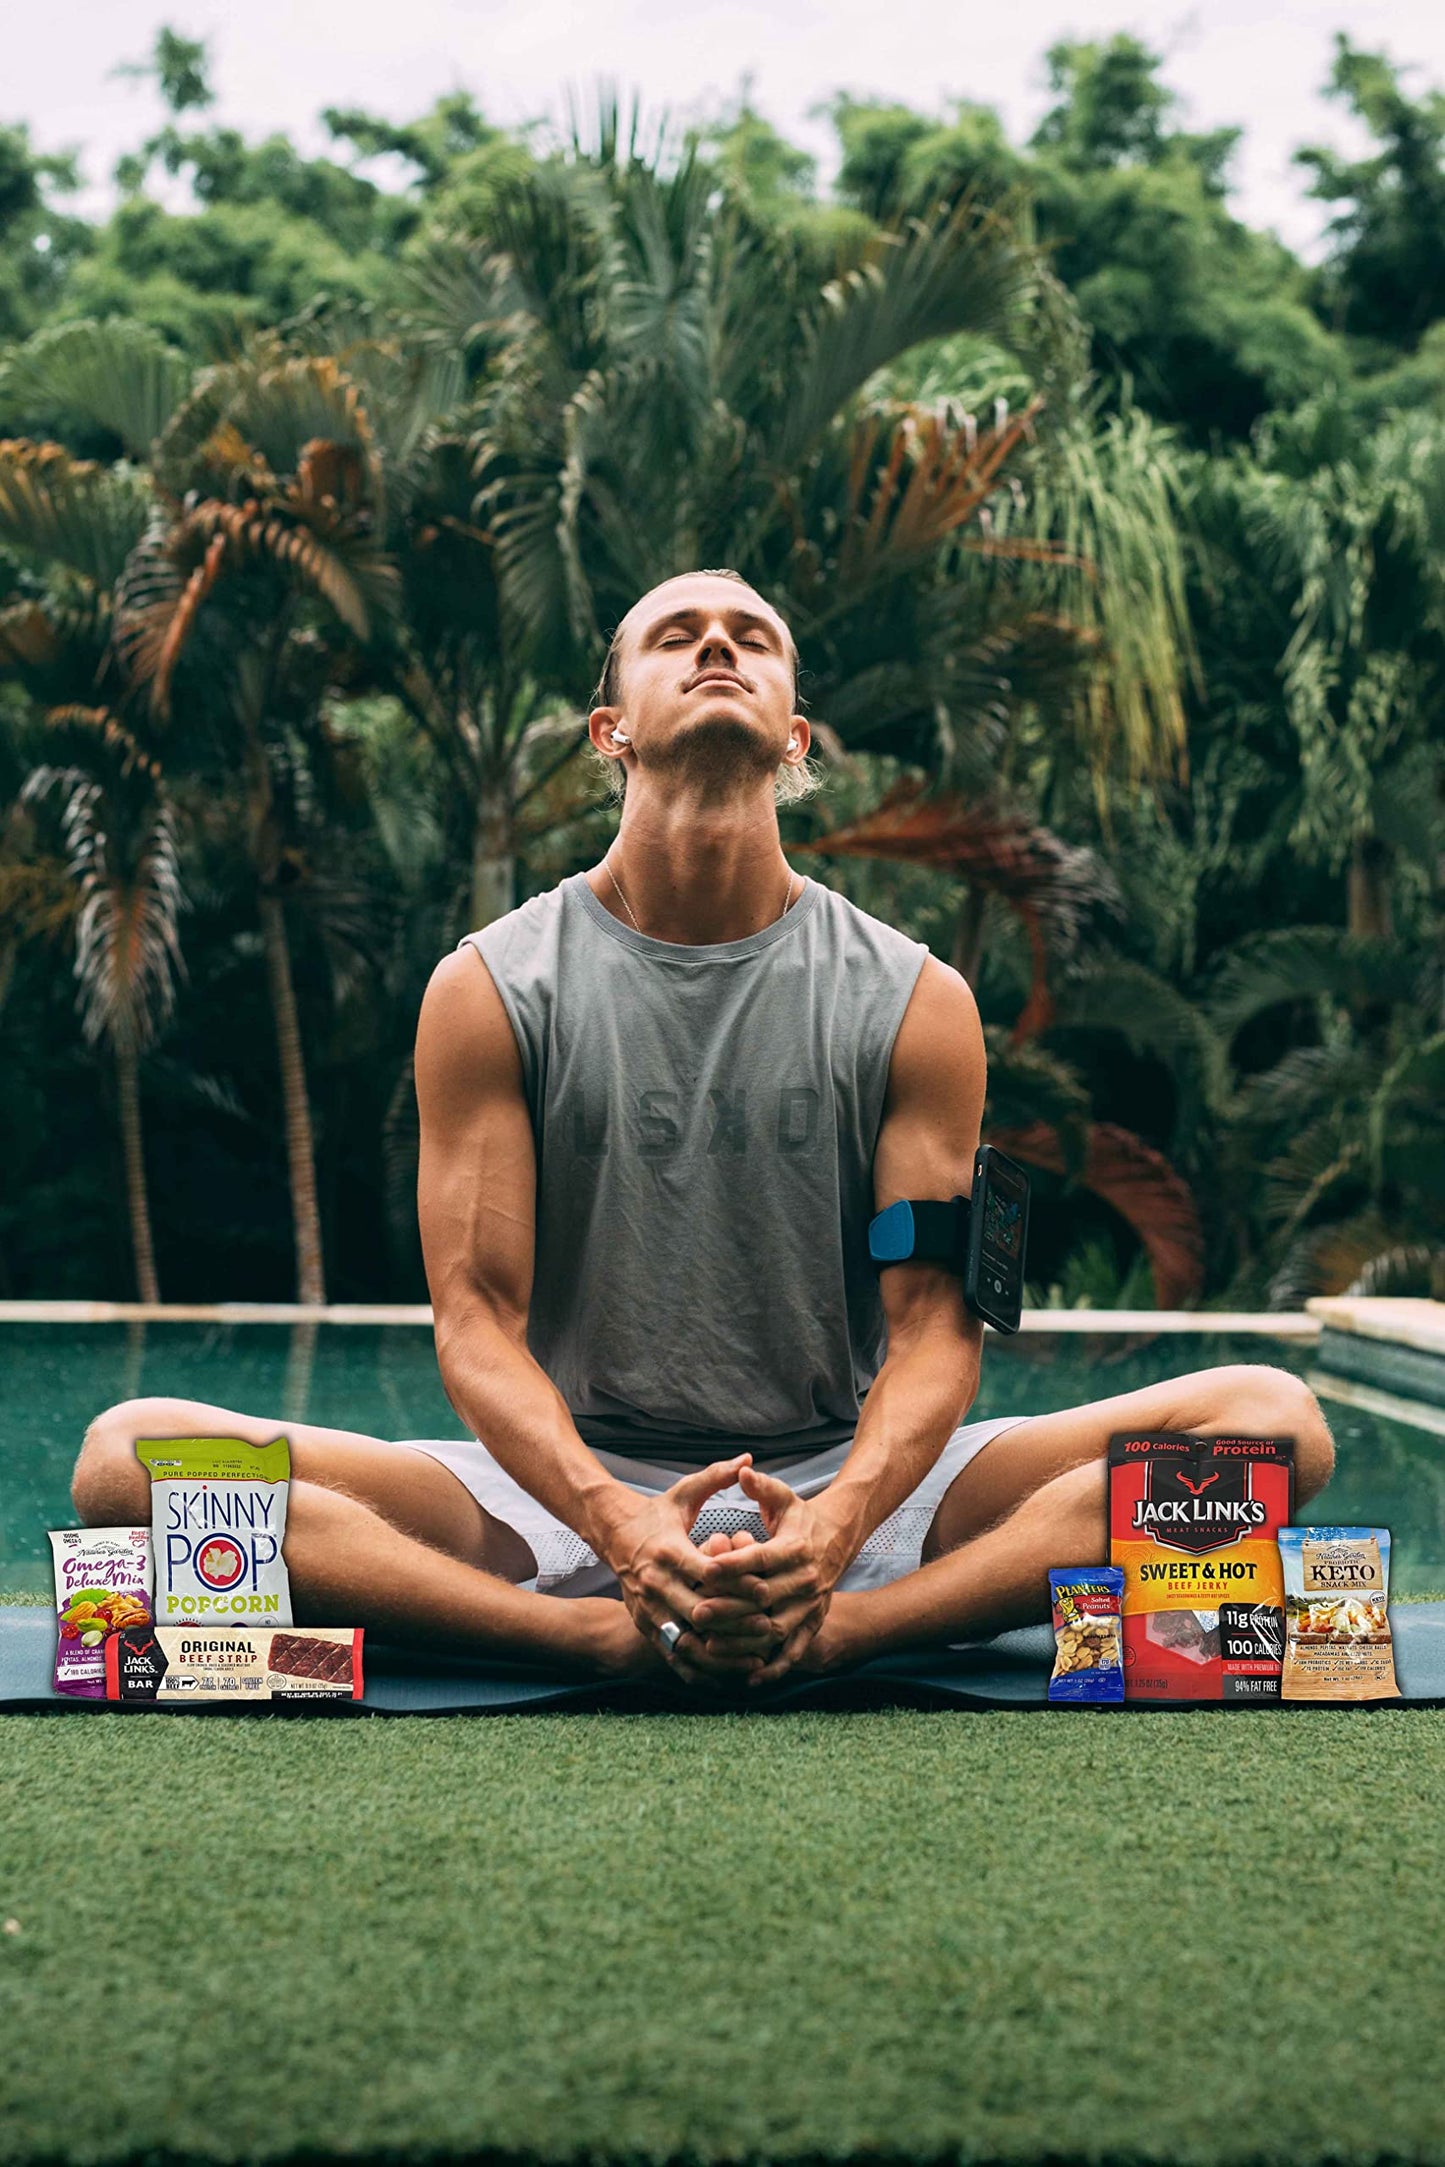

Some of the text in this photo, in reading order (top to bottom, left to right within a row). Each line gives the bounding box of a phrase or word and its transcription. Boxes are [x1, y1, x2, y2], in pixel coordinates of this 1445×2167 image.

[1124, 1441, 1190, 1453] 100 Calories
[1213, 1443, 1277, 1456] Protein
[166, 1485, 275, 1530] SKINNY
[1133, 1498, 1265, 1527] JACK LINK'S
[62, 1555, 147, 1578] Omega-3
[166, 1533, 278, 1592] POP
[1140, 1562, 1258, 1582] SWEET & HOT
[1310, 1564, 1375, 1581] KETO
[66, 1571, 144, 1590] Deluxe Mix
[1167, 1581, 1228, 1590] BEEF JERKY
[1055, 1583, 1112, 1598] PLANTERS
[166, 1593, 279, 1614] POPCORN
[1082, 1603, 1110, 1611] Peanuts
[1226, 1610, 1248, 1629] 11g
[181, 1640, 256, 1654] ORIGINAL
[1227, 1640, 1253, 1655] 100
[125, 1656, 151, 1666] JACK
[179, 1654, 258, 1663] BEEF STRIP
[1227, 1663, 1240, 1671] MADE
[1241, 1663, 1253, 1671] WITH
[1253, 1663, 1274, 1671] PREMIUM
[128, 1680, 153, 1689] BAR
[1235, 1680, 1277, 1693] 94% FAT FREE
